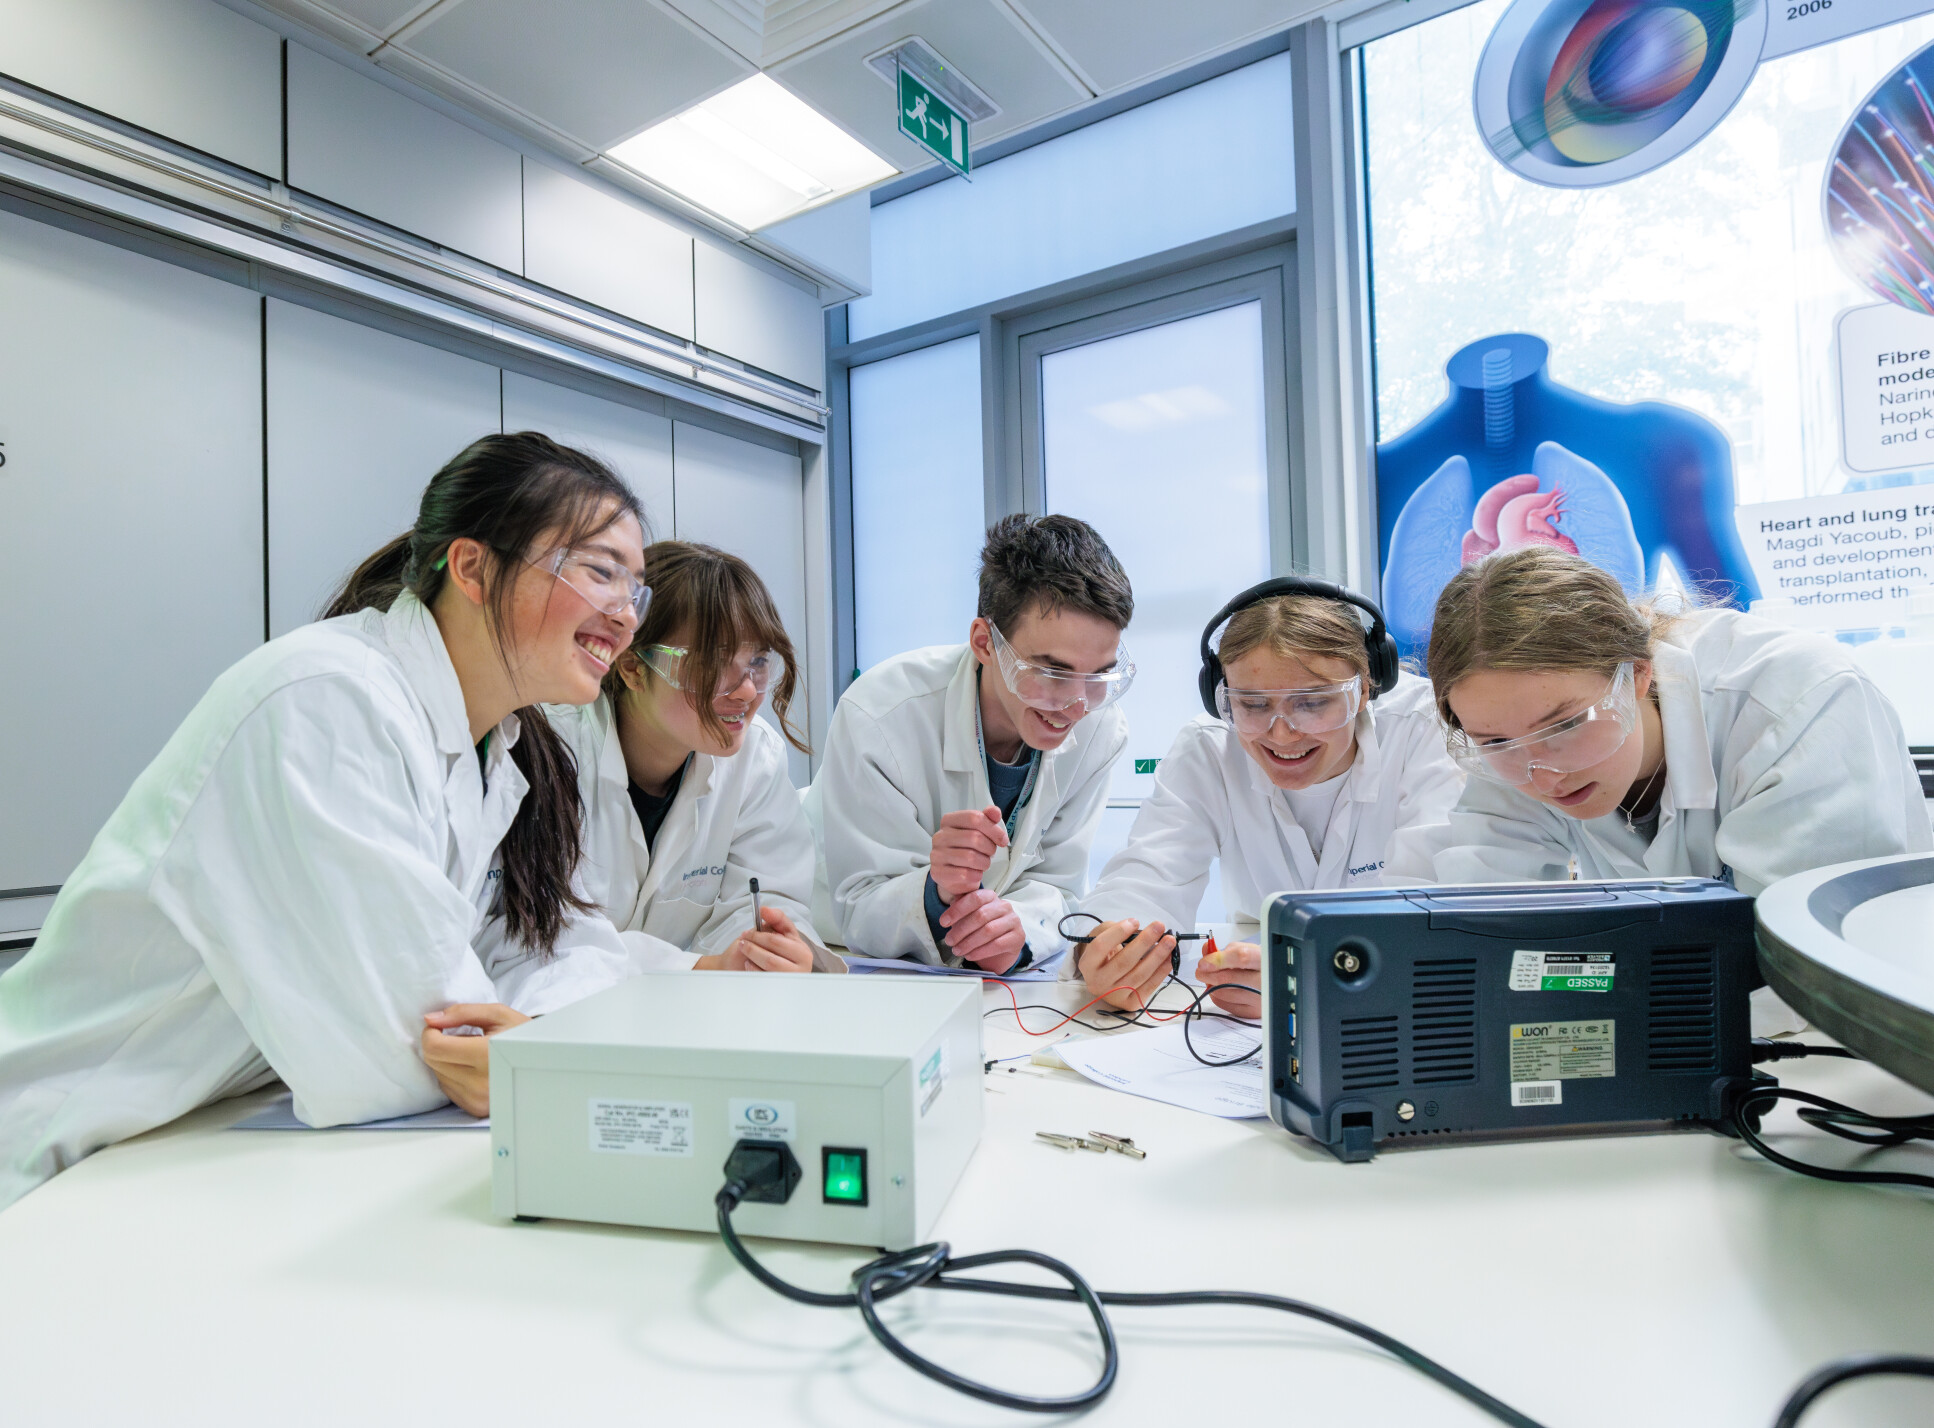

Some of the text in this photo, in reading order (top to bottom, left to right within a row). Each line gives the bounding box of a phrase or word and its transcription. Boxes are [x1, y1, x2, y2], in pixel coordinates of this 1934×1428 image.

[1787, 0, 1832, 20] 2006
[1878, 349, 1931, 367] Fibre
[1880, 387, 1934, 406] Narin
[1881, 406, 1934, 425] Hopk
[1881, 427, 1918, 445] and
[1761, 504, 1934, 533] Heart and lung tr
[1767, 522, 1934, 551] Magdi Yacoub, pi
[1773, 544, 1934, 570] and developmen
[1779, 566, 1928, 588] transplantation,
[682, 865, 708, 881] Ierial
[1567, 978, 1609, 988] PASSED
